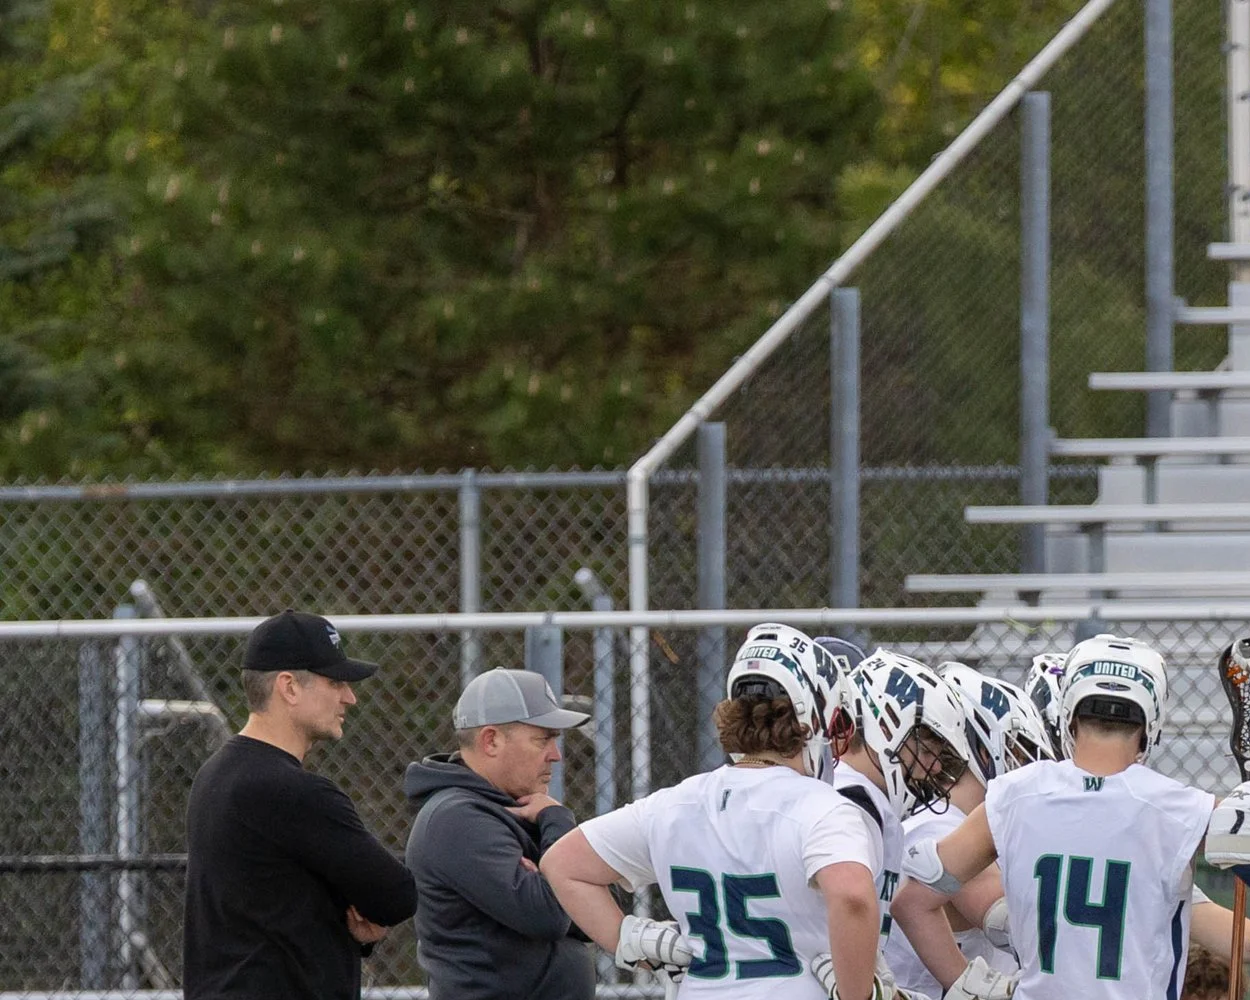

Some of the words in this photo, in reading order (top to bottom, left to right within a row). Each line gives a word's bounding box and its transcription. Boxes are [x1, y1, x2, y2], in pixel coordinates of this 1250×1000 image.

[788, 637, 809, 654] 35
[884, 666, 921, 711] W
[1093, 660, 1138, 679] UNITED
[980, 680, 1011, 722] W
[1083, 775, 1105, 792] W
[670, 865, 804, 980] 35
[1033, 853, 1131, 981] 14
